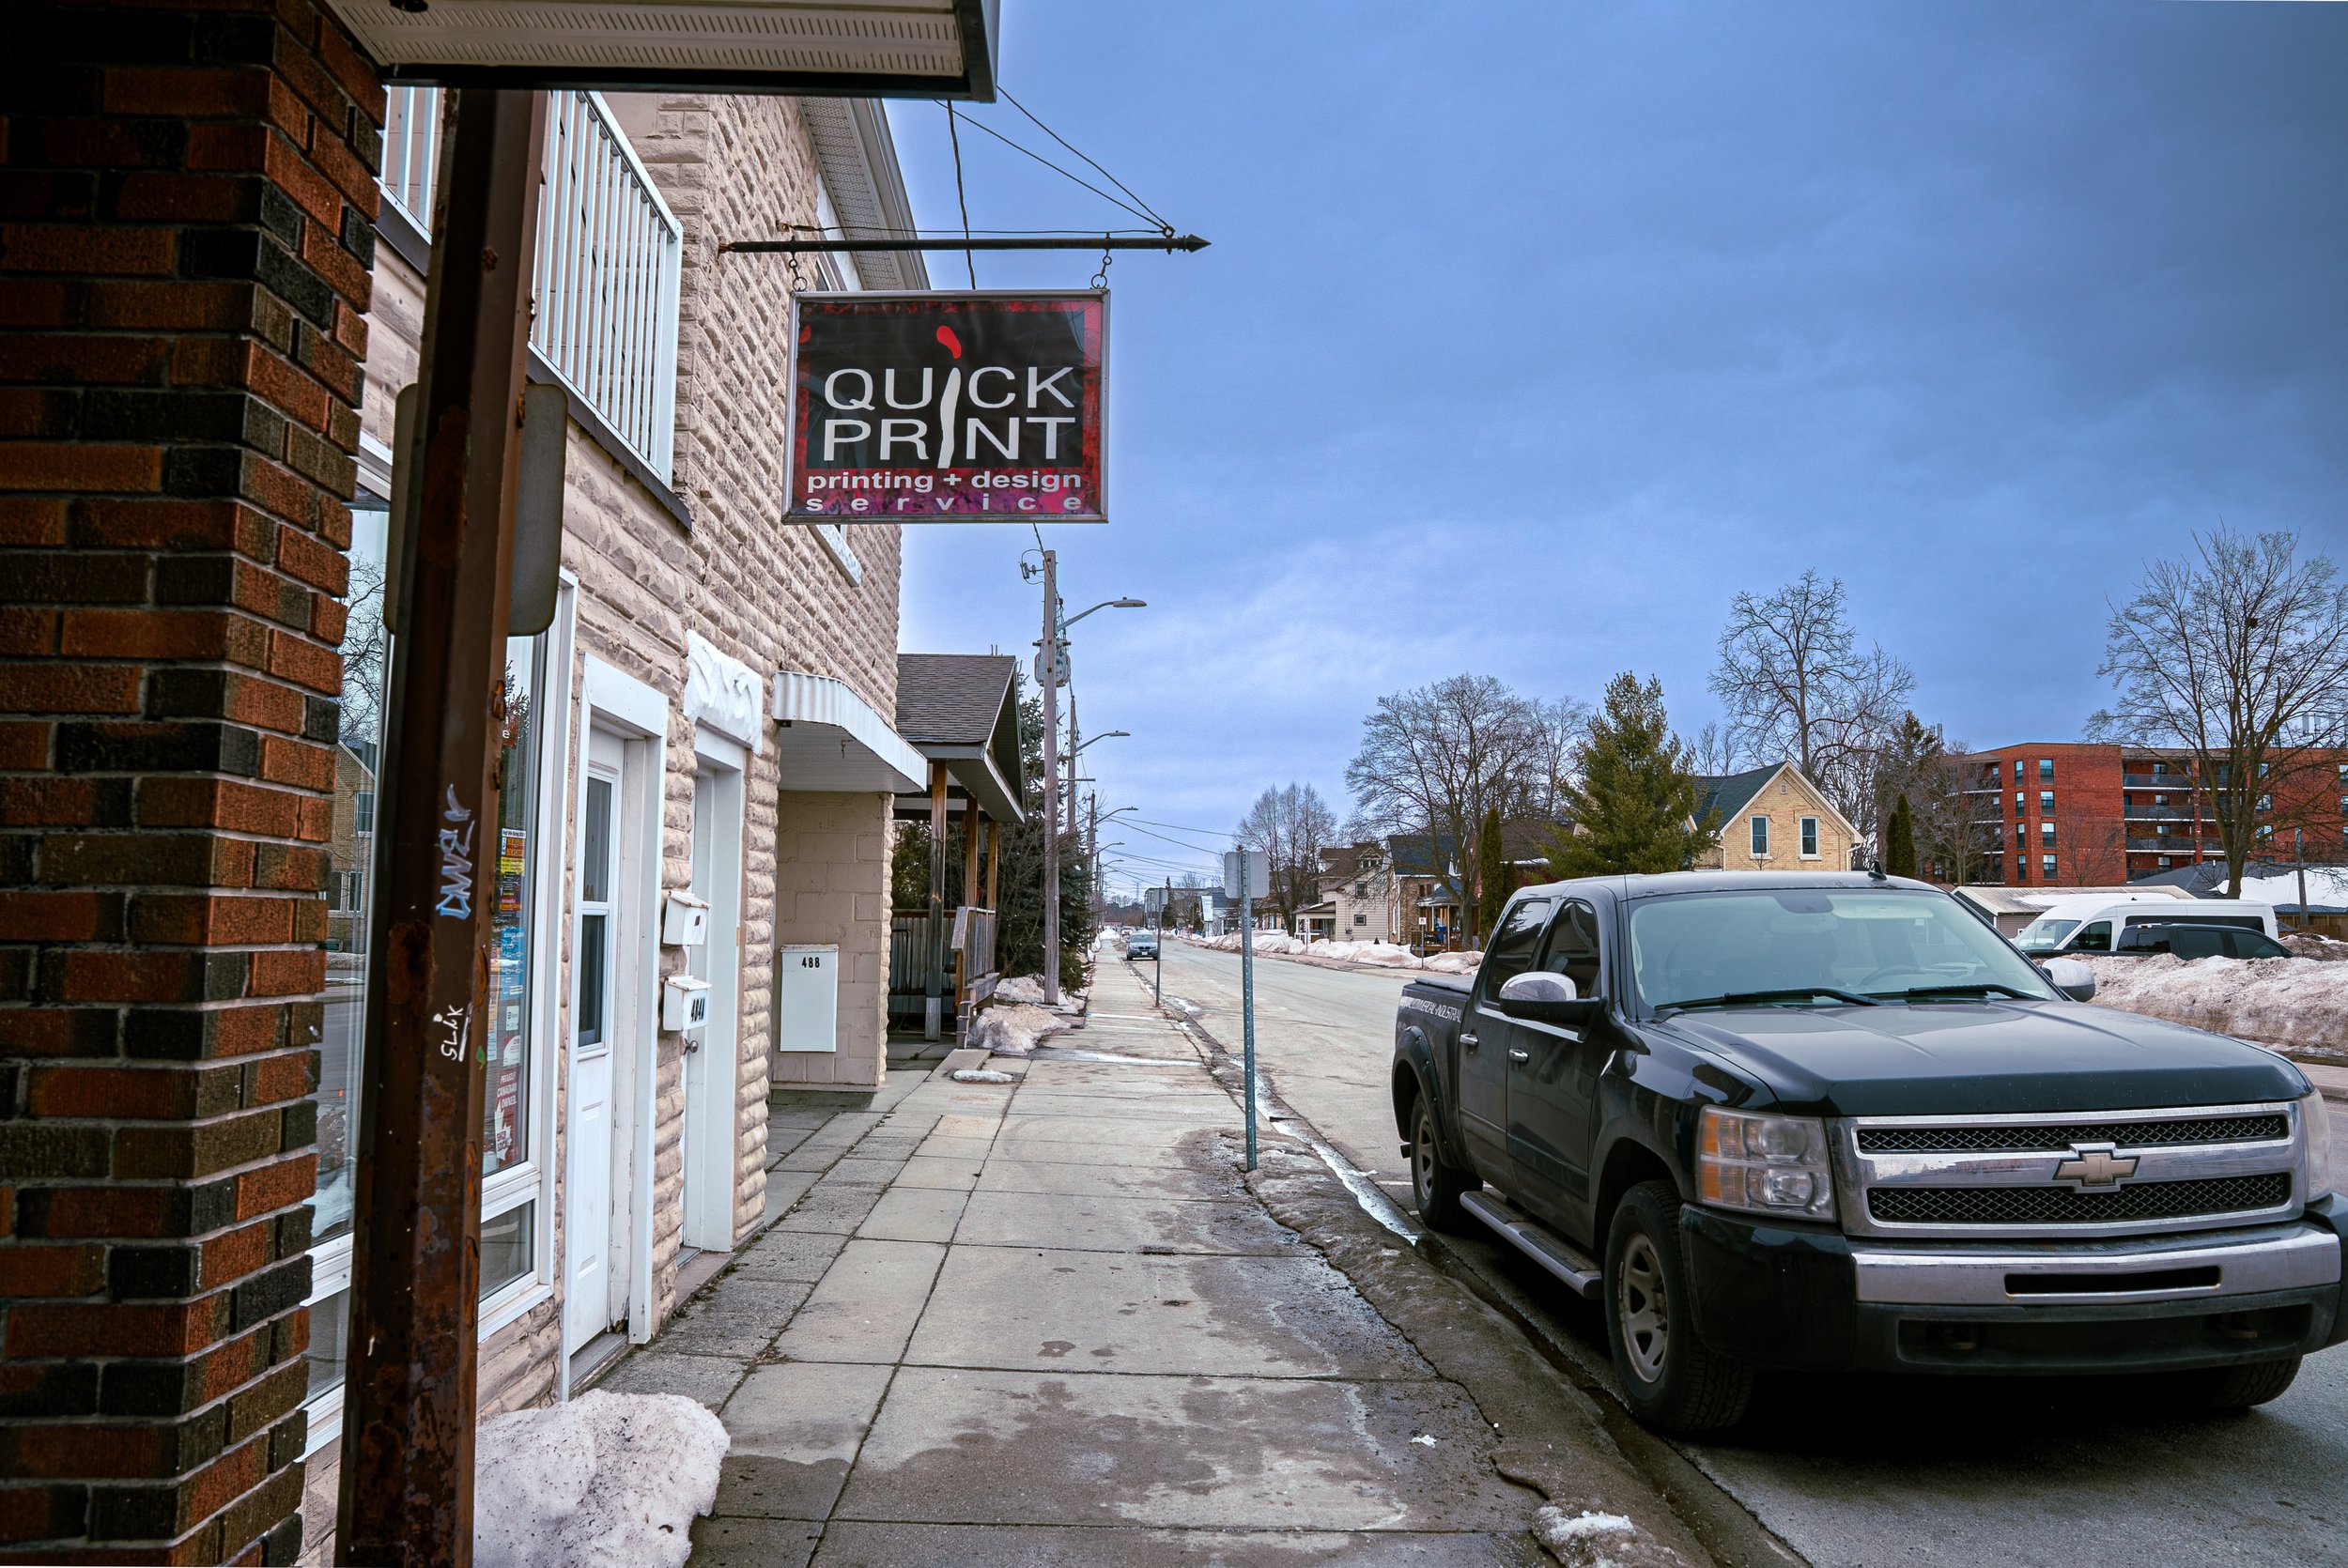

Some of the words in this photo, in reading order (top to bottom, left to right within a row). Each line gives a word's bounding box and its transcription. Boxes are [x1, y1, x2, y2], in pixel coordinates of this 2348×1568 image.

[807, 471, 934, 493] printing
[943, 472, 963, 487] +
[971, 470, 1082, 492] design
[805, 493, 1083, 512] service
[801, 956, 821, 968] 488
